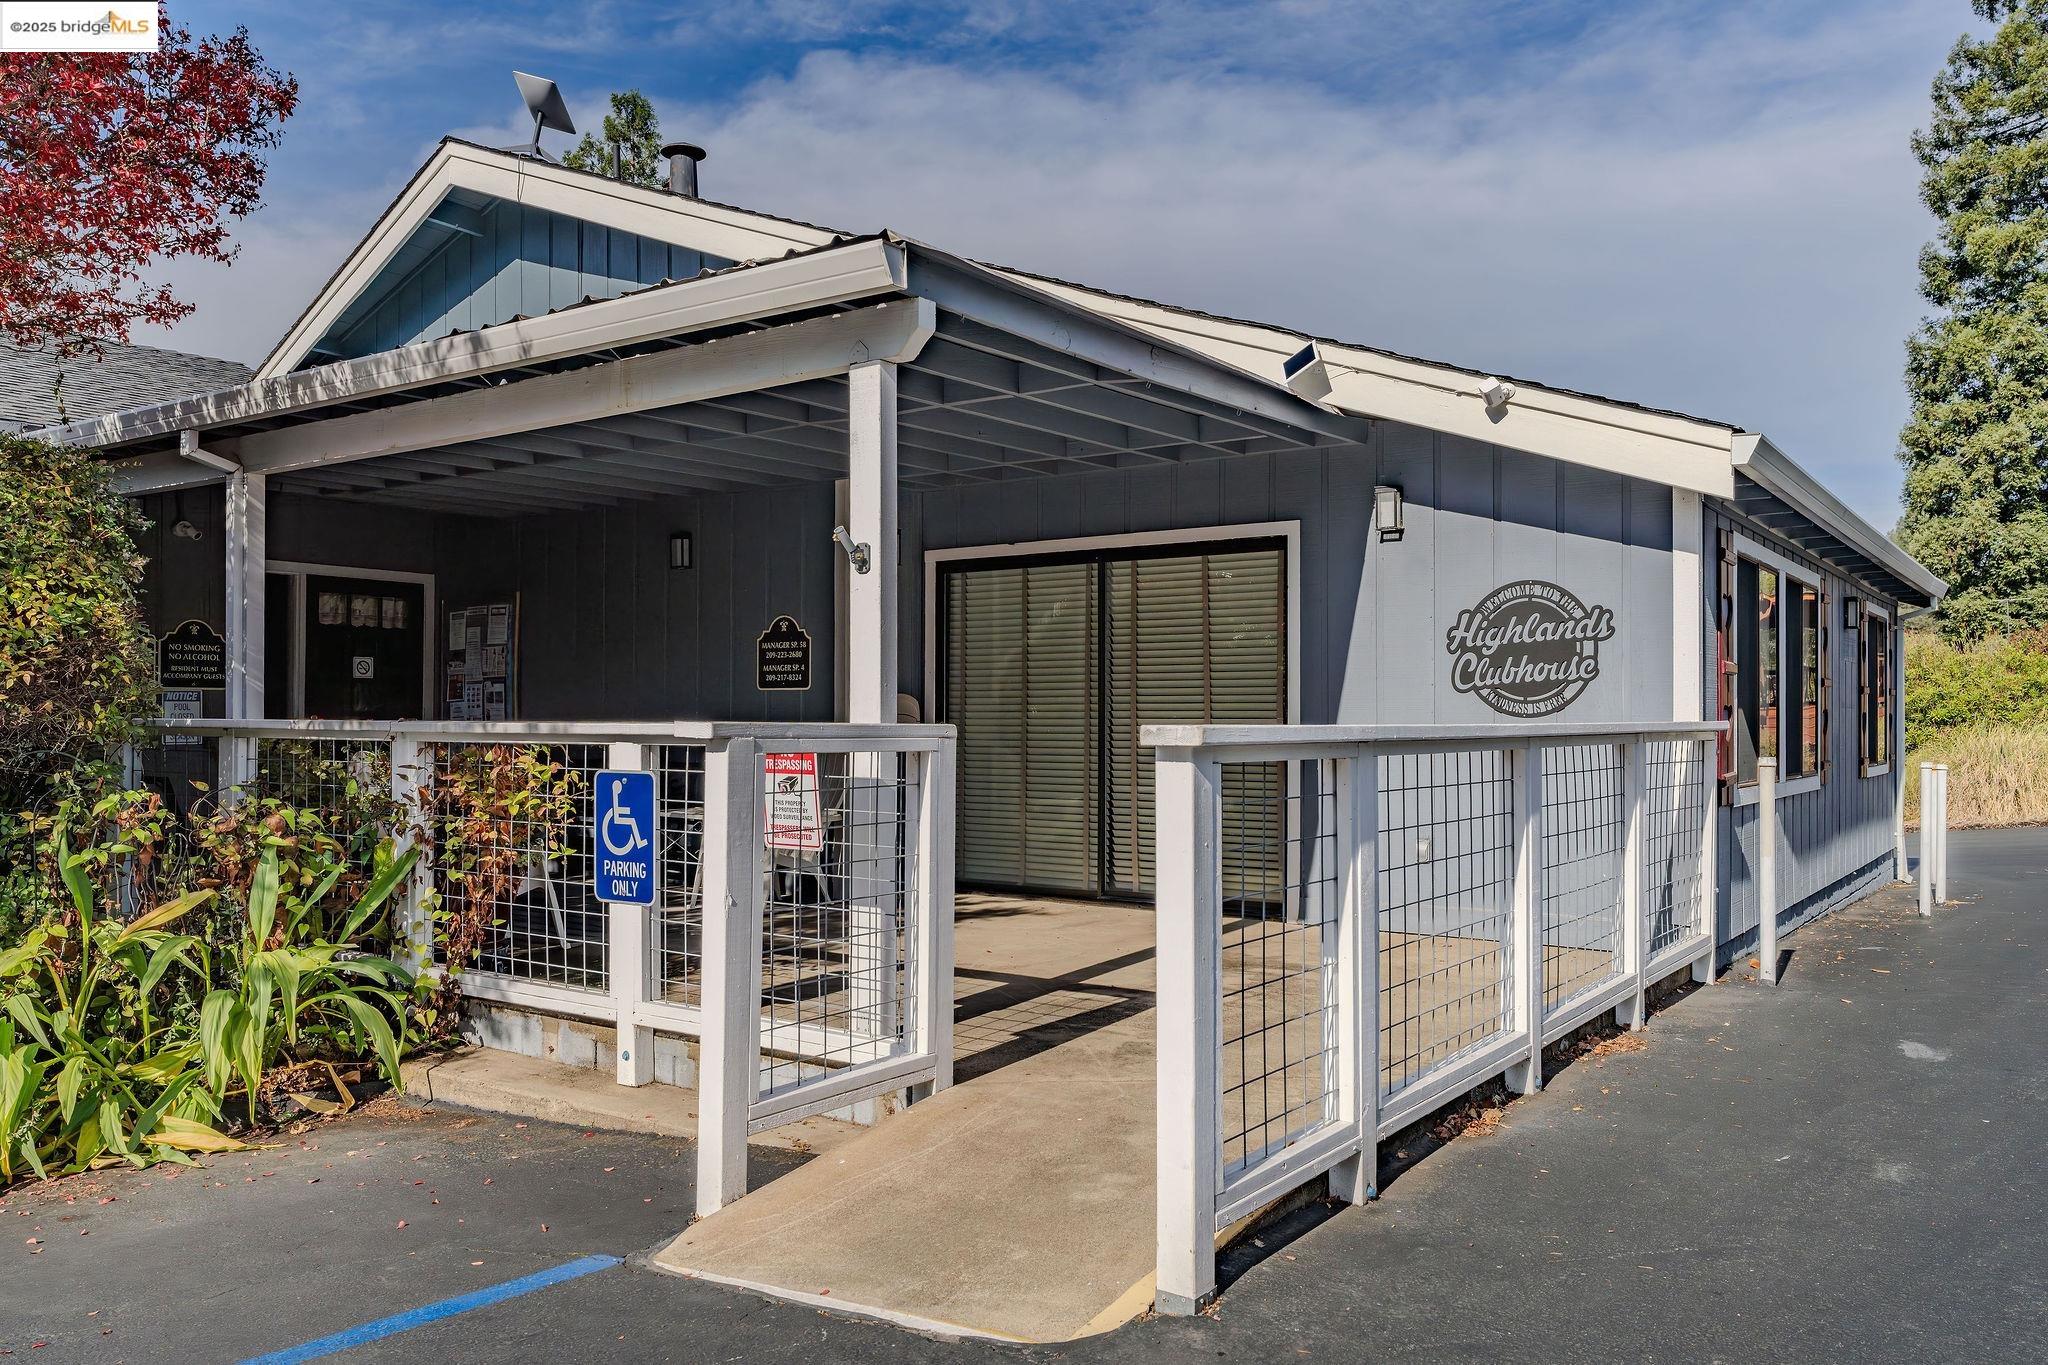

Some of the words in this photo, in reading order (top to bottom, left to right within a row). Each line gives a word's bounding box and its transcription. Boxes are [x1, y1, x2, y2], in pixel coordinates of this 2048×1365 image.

[1480, 584, 1535, 615] WELCOME
[1539, 585, 1555, 599] TO
[1558, 591, 1578, 616] THE
[1449, 607, 1612, 656] Highlands
[169, 643, 182, 651] NO
[183, 643, 221, 652] SMOKING
[169, 652, 182, 660] NO
[182, 653, 220, 661] ALCOHOL
[1454, 651, 1597, 690] Clubhouse
[166, 691, 199, 701] NOTICE
[1485, 688, 1529, 714] KINDNESS
[1533, 699, 1542, 714] IS
[1543, 692, 1568, 713] FREE
[173, 702, 191, 711] POOL
[783, 813, 813, 821] SURVEILANCE
[604, 860, 646, 879] PARKING
[612, 879, 638, 897] ONLY
